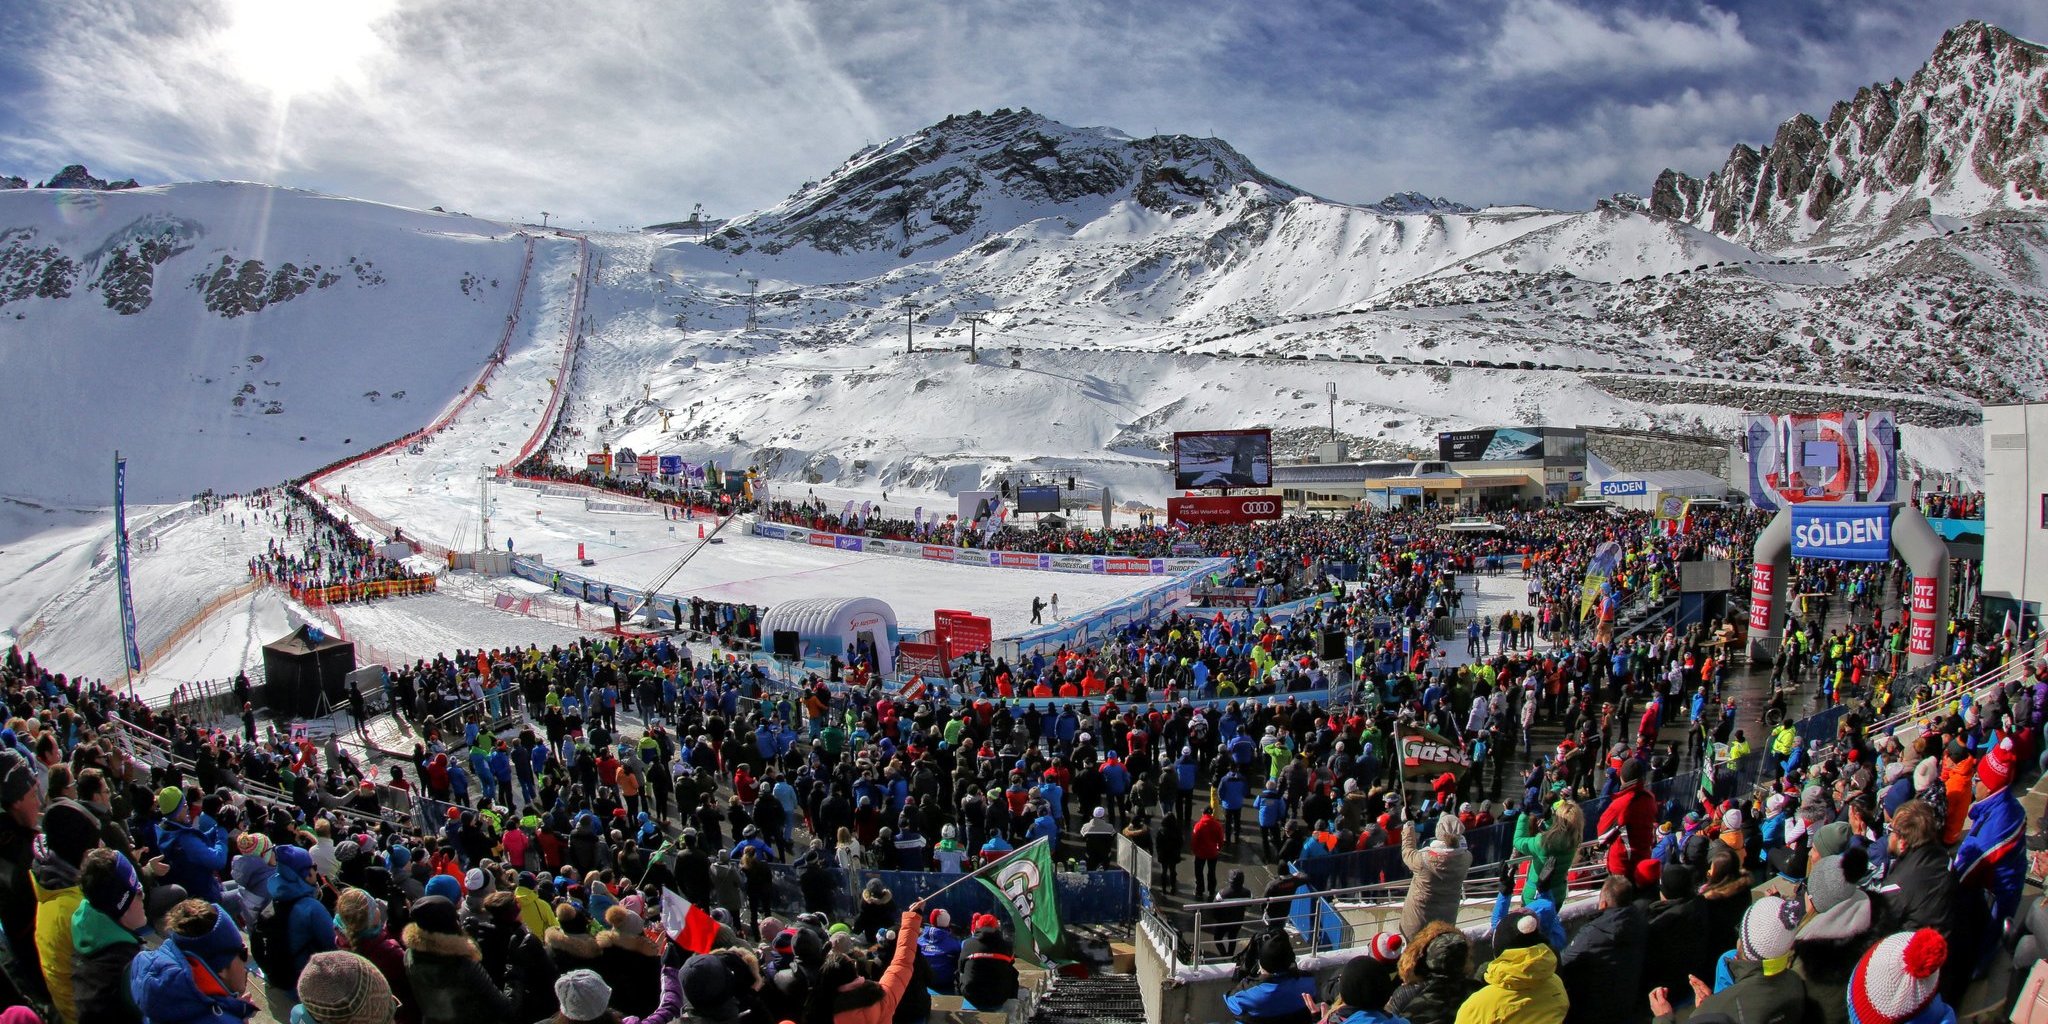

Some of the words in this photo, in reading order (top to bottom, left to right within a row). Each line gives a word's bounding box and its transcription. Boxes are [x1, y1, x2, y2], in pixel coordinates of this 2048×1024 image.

[1604, 482, 1642, 494] SÖLDEN
[1796, 516, 1883, 548] SÖLDEN
[1106, 561, 1126, 570] Kronen
[1128, 561, 1149, 571] Zeitung
[1753, 566, 1770, 580] ÖTZ
[1753, 580, 1769, 591] TAL
[1914, 581, 1933, 596] ÖTZ
[1751, 601, 1768, 615] ÖTZ
[1914, 597, 1933, 609] TAL
[1751, 615, 1766, 626] TAL
[1912, 622, 1931, 638] ÖTZ
[1912, 638, 1930, 651] TAL
